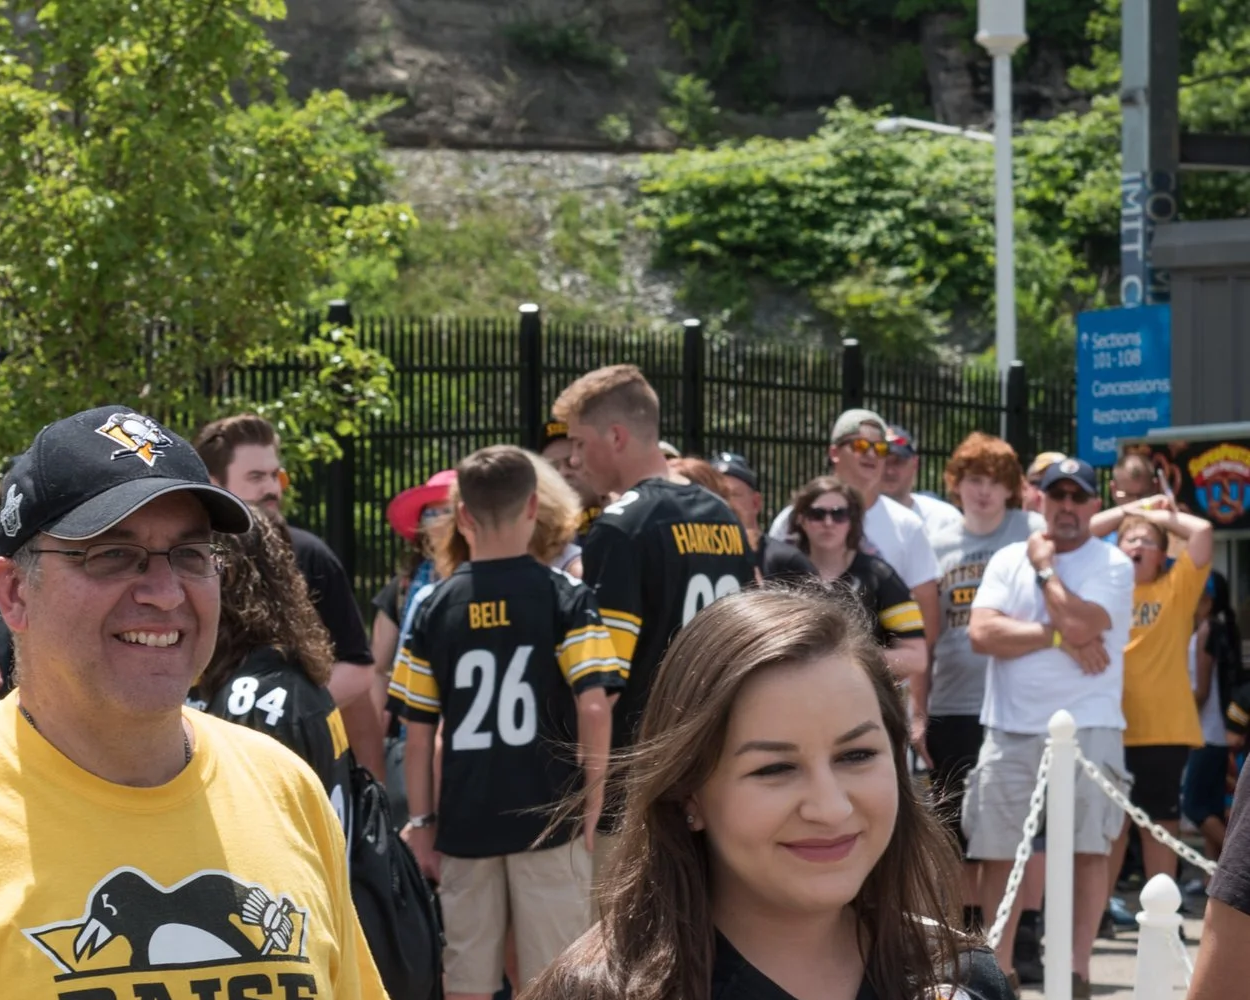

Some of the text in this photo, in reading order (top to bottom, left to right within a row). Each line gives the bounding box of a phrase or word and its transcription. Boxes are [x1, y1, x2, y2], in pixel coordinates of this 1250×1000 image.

[1092, 332, 1141, 350] Sections
[1093, 350, 1141, 369] 101-108
[1092, 378, 1171, 398] Concessions
[1093, 407, 1157, 424] Restrooms
[671, 522, 744, 556] HARRISON
[469, 601, 510, 629] BELL
[228, 676, 288, 727] 84
[452, 645, 538, 751] 26
